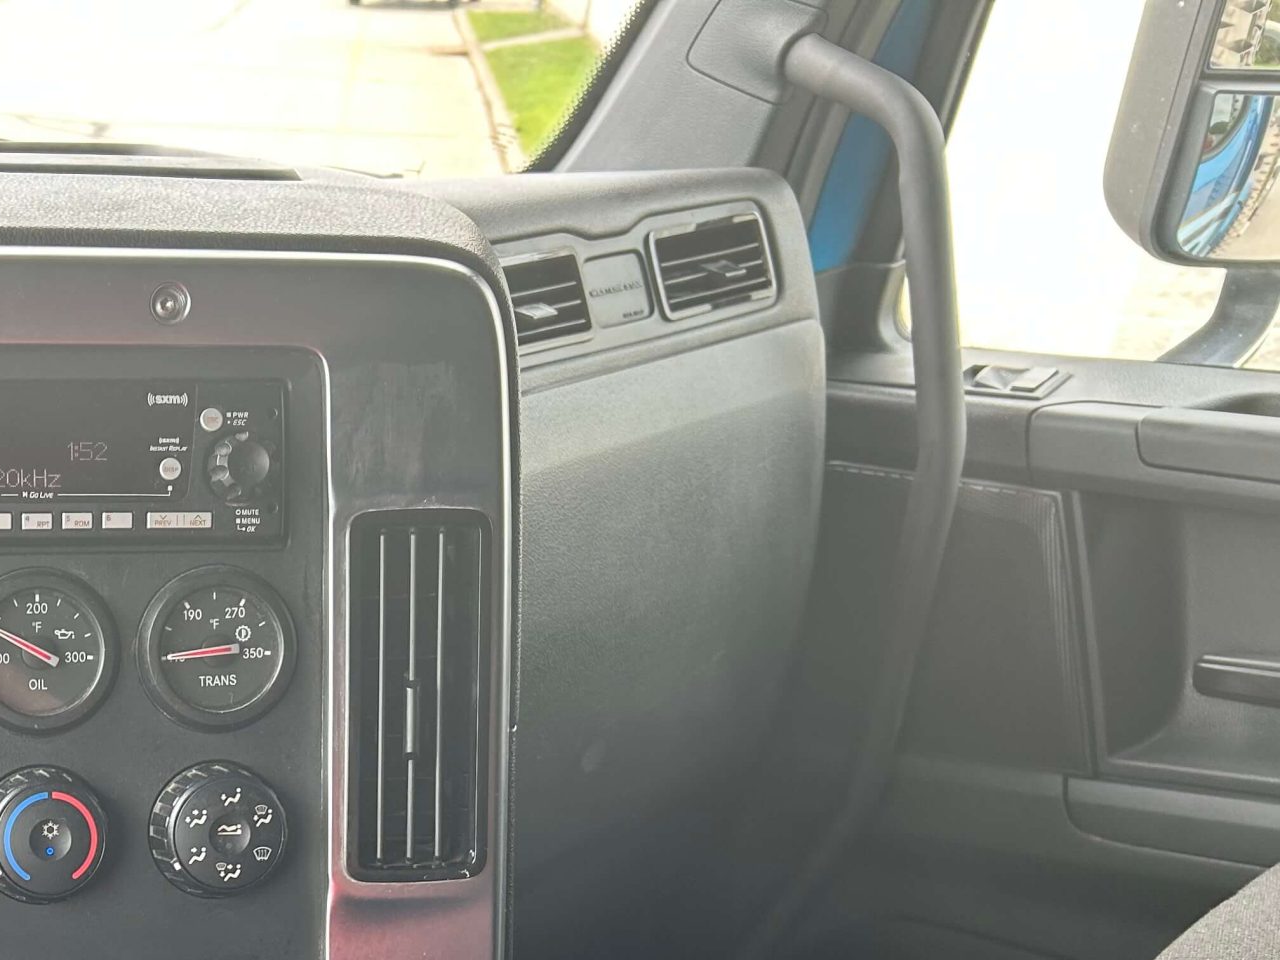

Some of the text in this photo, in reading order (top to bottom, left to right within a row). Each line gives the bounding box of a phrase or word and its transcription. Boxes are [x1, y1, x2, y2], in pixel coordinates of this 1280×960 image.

[67, 441, 108, 461] 1:52
[154, 519, 172, 527] PREV
[189, 519, 207, 527] NEXT
[246, 525, 256, 533] OK
[25, 602, 48, 615] 200
[224, 607, 246, 619] 270
[183, 609, 203, 621] 190
[64, 651, 86, 663] 300
[242, 647, 264, 659] 350
[28, 679, 48, 691] OIL
[199, 674, 237, 687] TRANS
